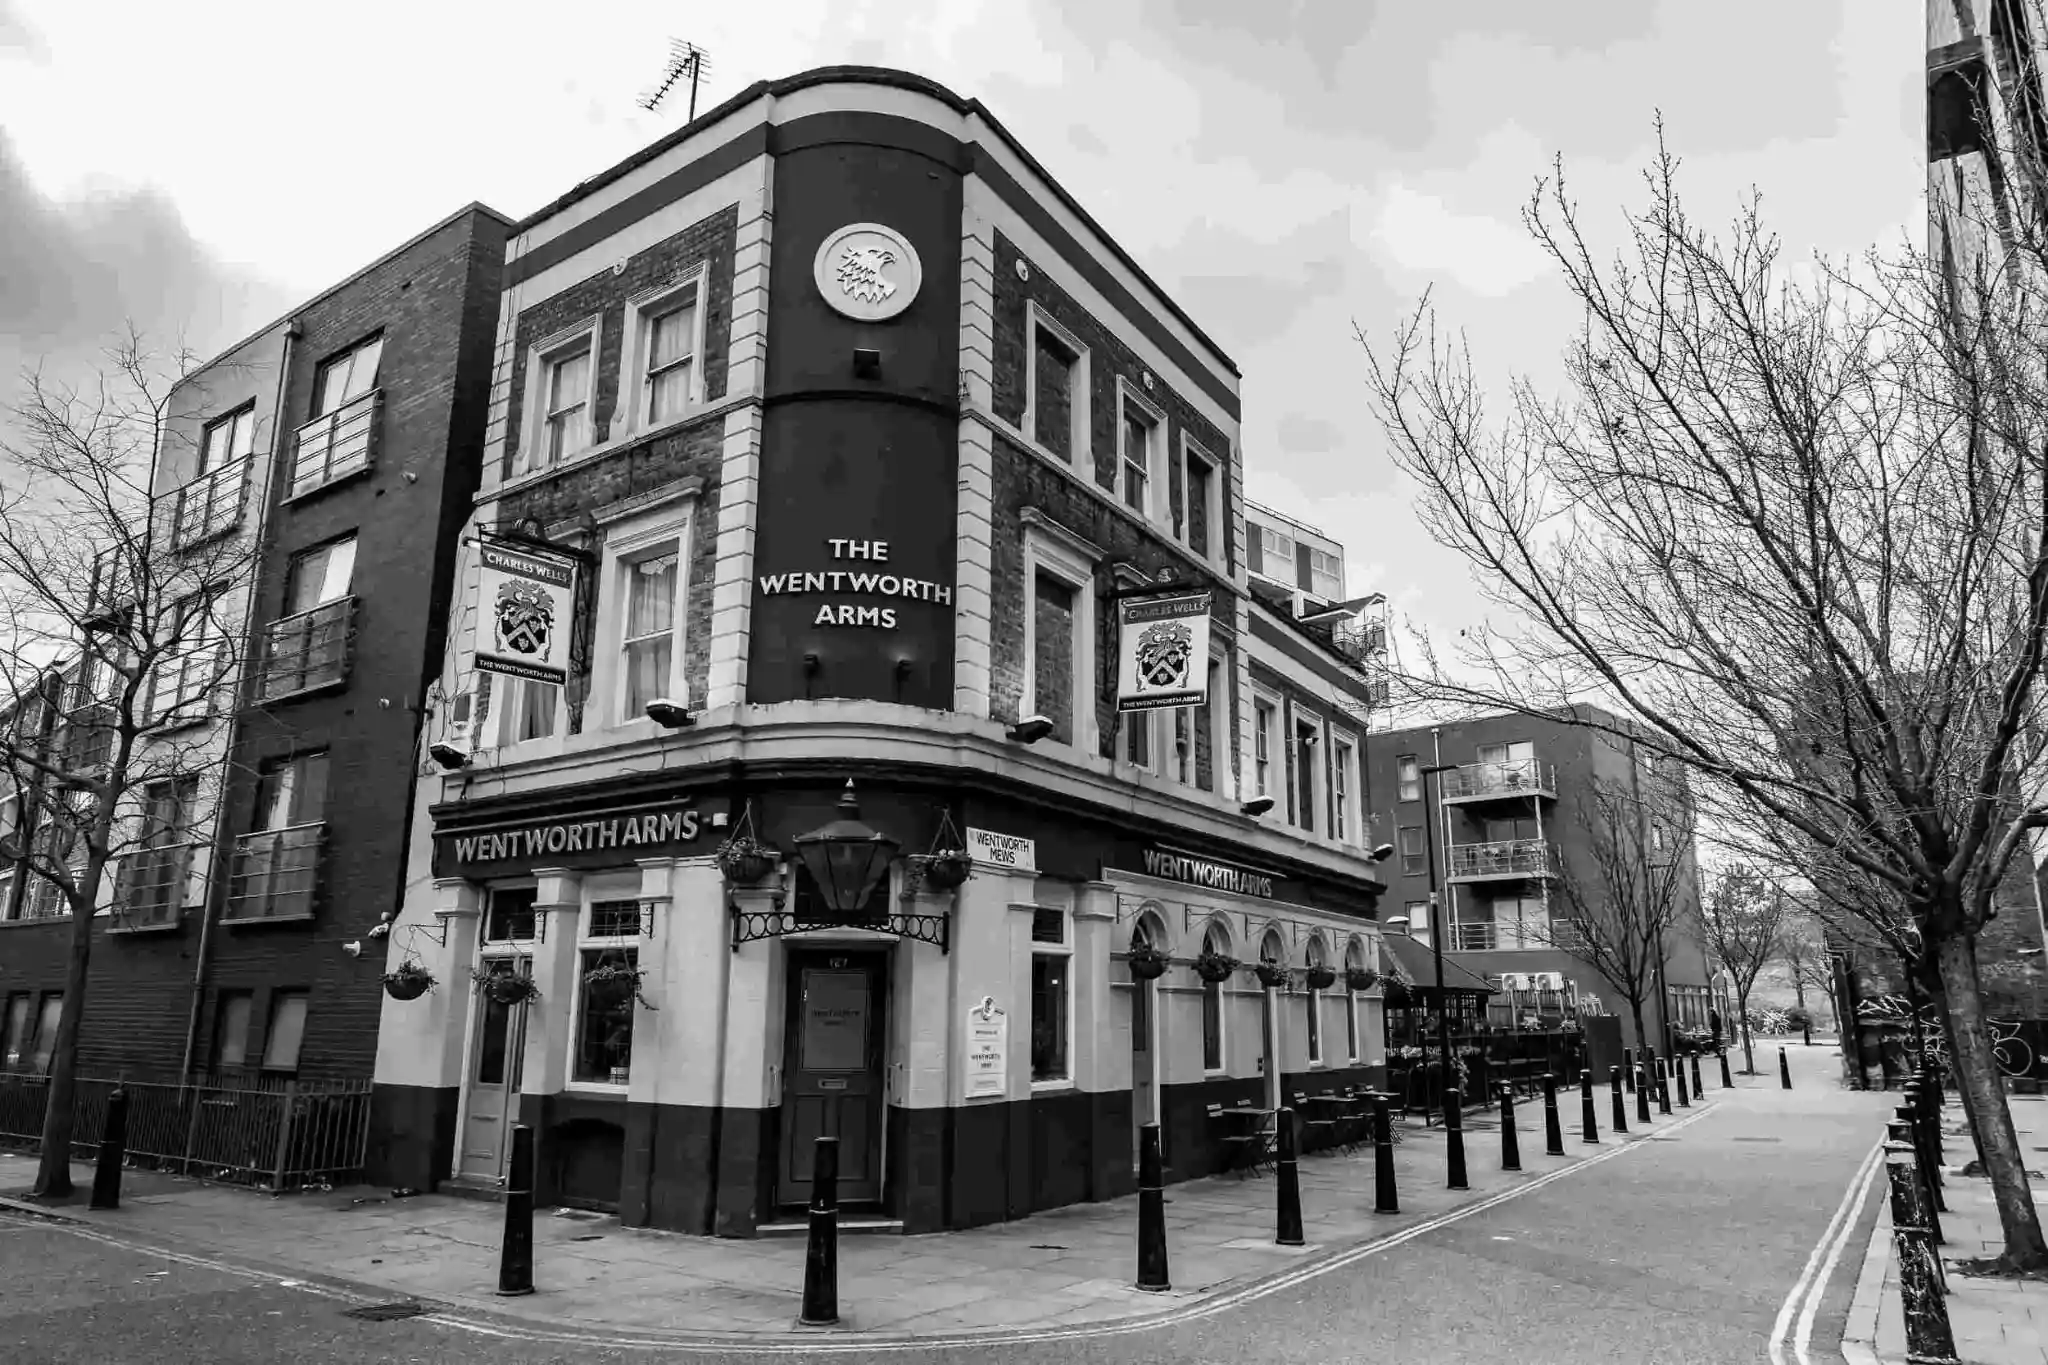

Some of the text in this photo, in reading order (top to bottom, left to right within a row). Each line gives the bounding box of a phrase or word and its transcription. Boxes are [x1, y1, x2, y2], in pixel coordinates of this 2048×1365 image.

[828, 539, 888, 561] THE
[487, 552, 567, 583] CHARLES WELLS
[759, 571, 951, 605] WENTWORTH
[814, 604, 897, 629] ARMS
[455, 811, 699, 864] WENTWORTH ARMS
[976, 831, 1029, 853] WENTWORTH
[990, 847, 1016, 864] MEWS
[1143, 849, 1272, 898] WENTWORTH ARMS
